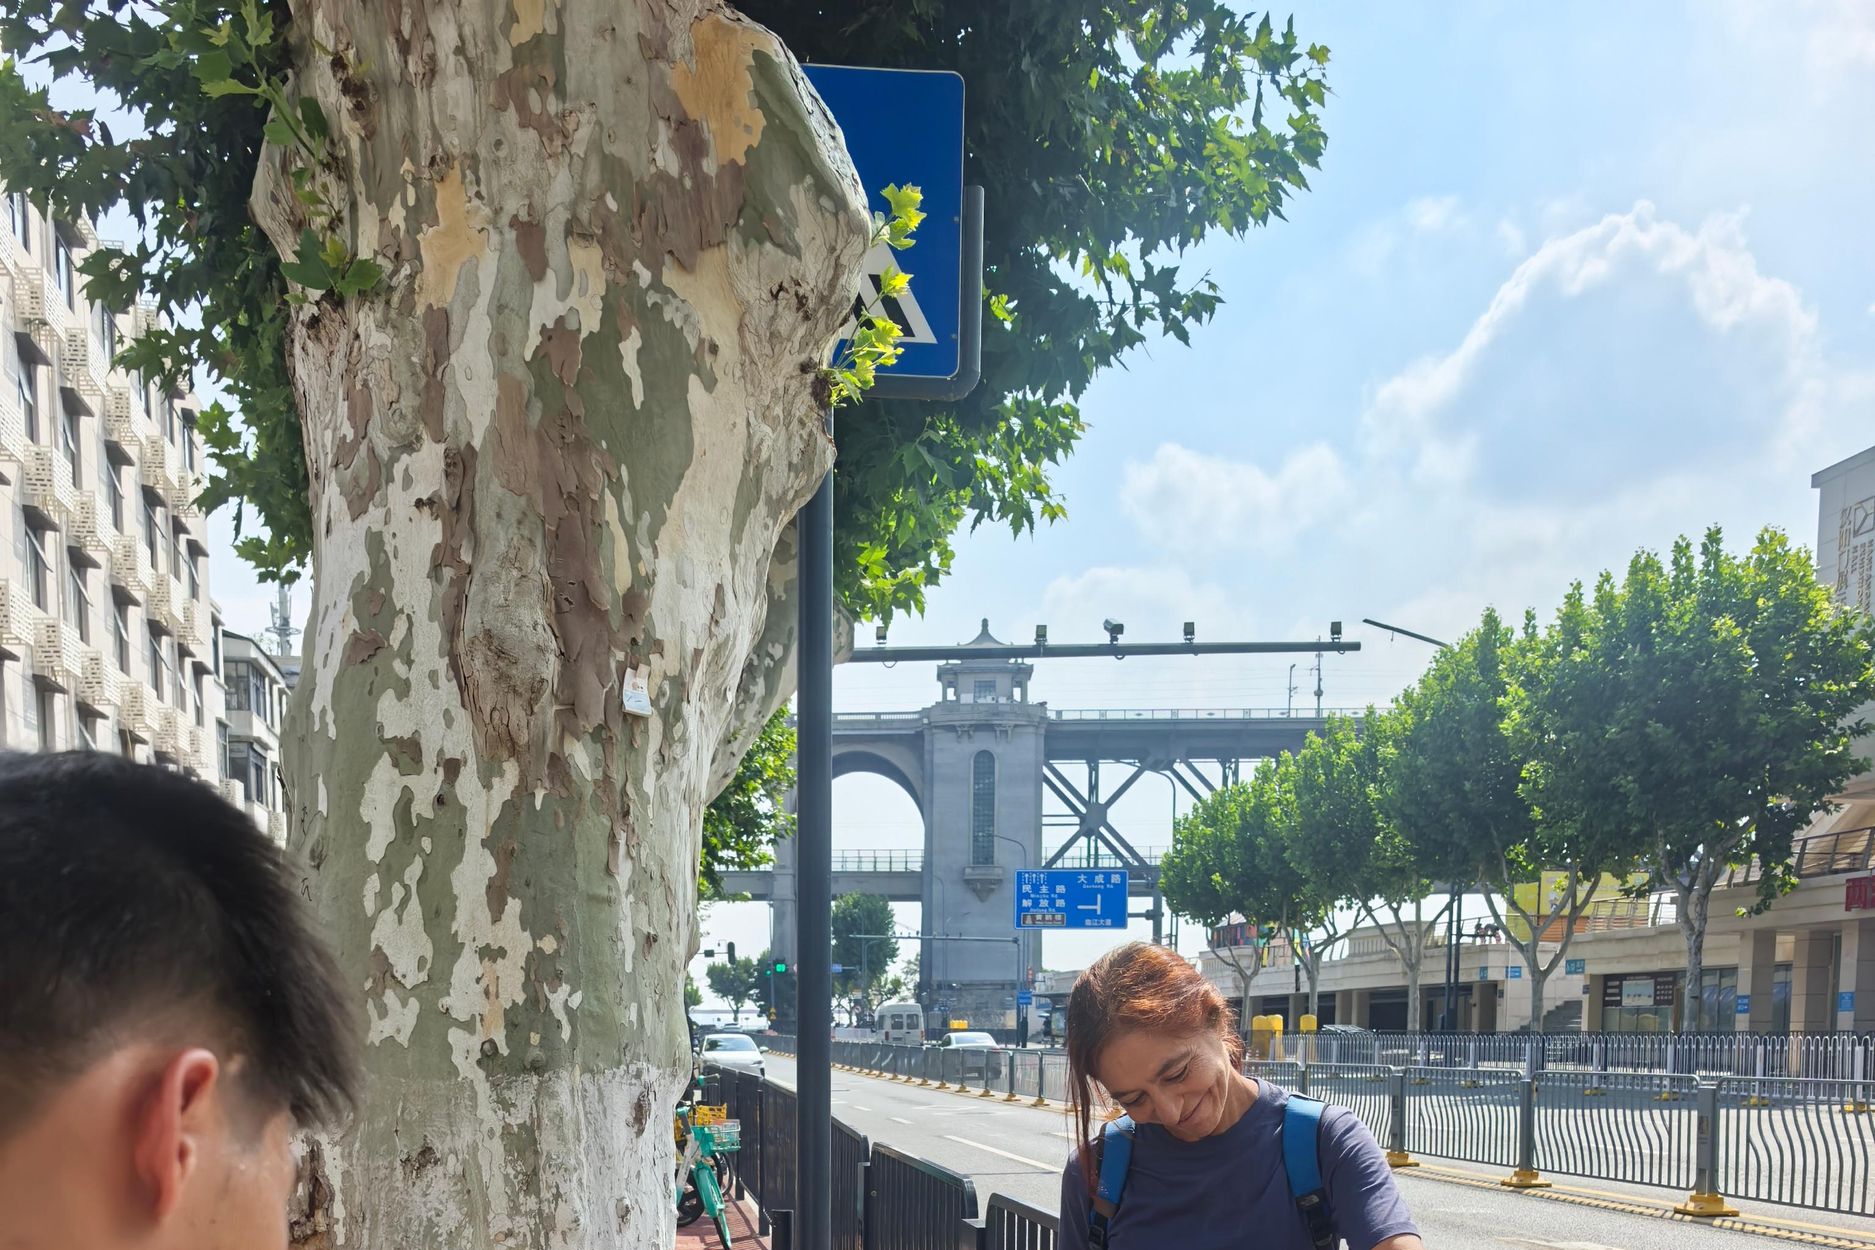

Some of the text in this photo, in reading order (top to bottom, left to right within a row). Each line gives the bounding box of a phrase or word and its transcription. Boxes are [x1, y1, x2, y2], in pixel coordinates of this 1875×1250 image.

[1077, 874, 1121, 884] 大成路
[1022, 885, 1066, 893] 民主路
[1022, 899, 1065, 907] 解放路
